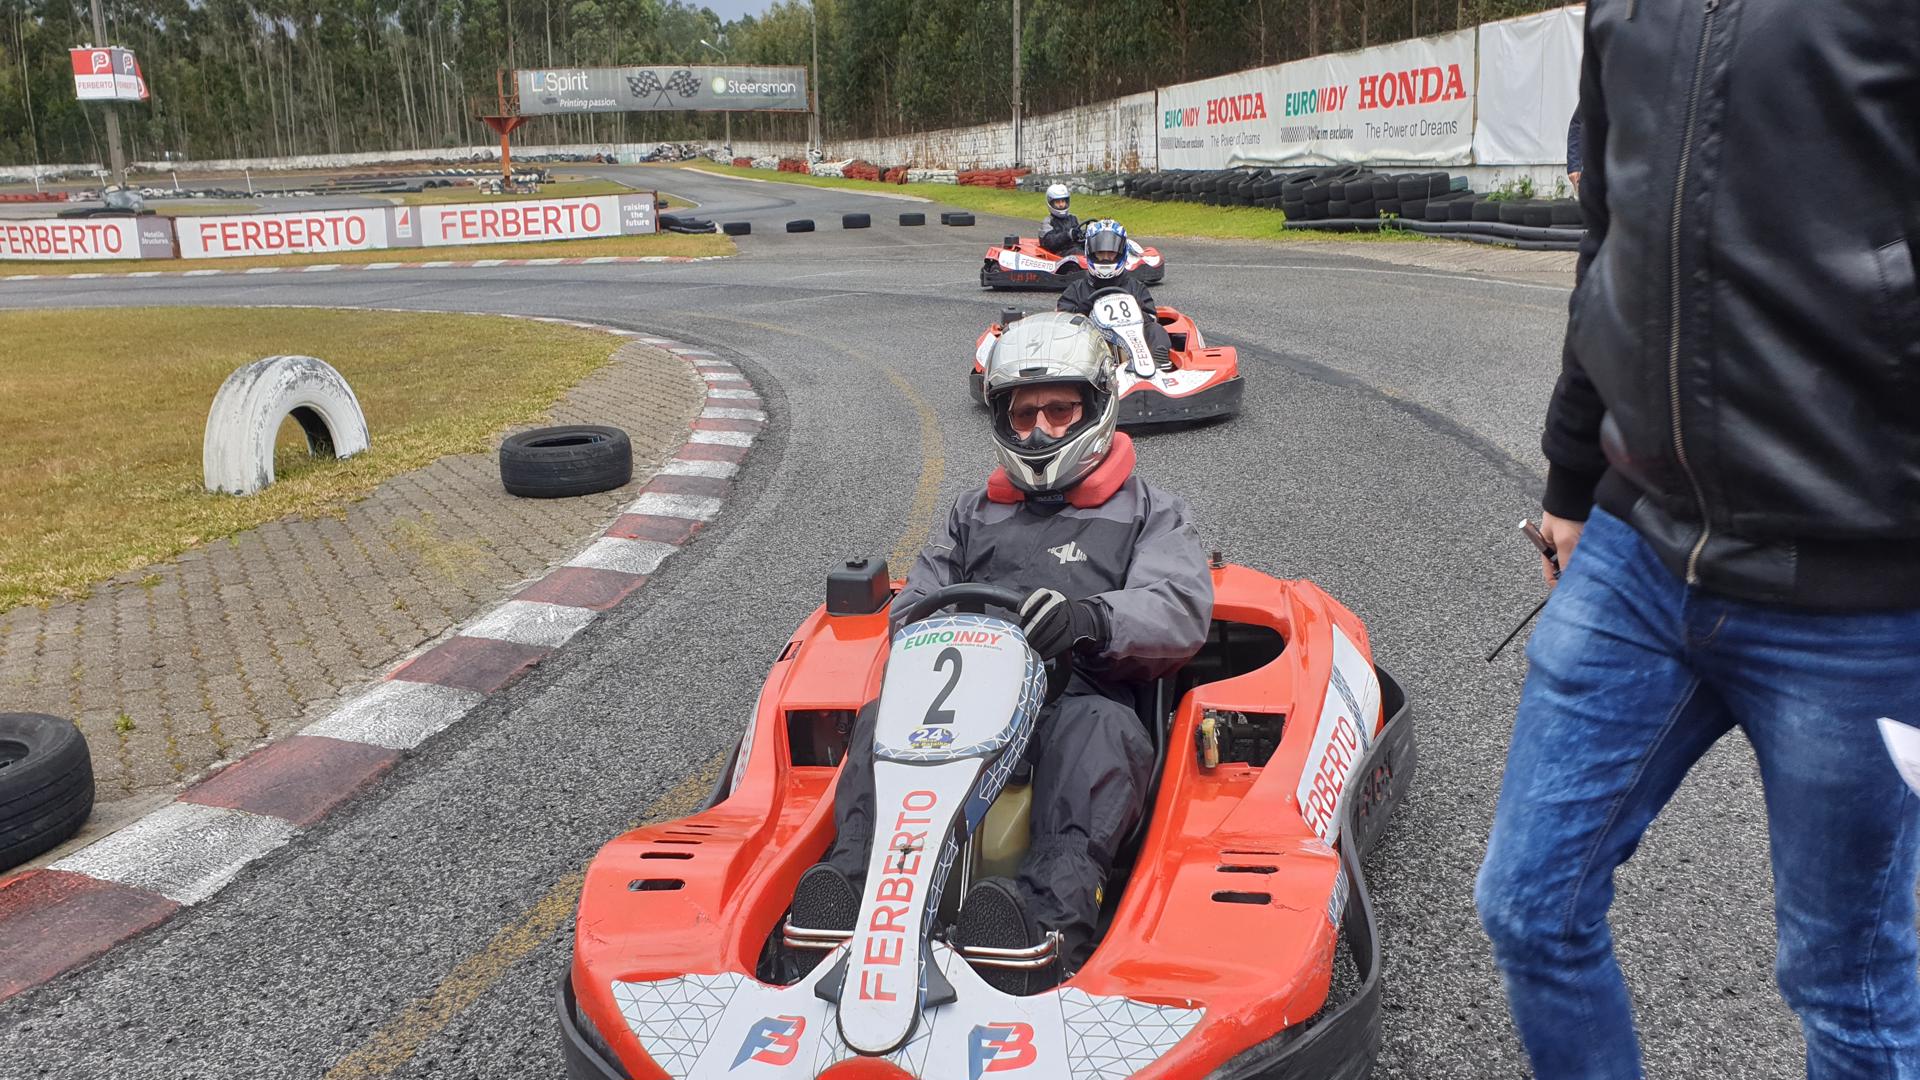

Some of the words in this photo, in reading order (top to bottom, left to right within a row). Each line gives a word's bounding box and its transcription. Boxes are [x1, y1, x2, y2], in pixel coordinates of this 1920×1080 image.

[546, 71, 589, 95] Spirit
[728, 80, 796, 93] Steersman
[1285, 85, 1348, 117] EUROINDY
[1358, 64, 1467, 110] HONDA
[560, 99, 588, 109] Printing
[1207, 93, 1267, 125] HONDA
[1365, 122, 1381, 139] The
[1383, 120, 1408, 138] Power
[1420, 119, 1458, 137] Dreams
[624, 203, 650, 214] raising
[631, 210, 644, 219] the
[438, 203, 601, 240] FERBERTO
[626, 218, 650, 227] future
[200, 215, 366, 252] FERBERTO
[1104, 300, 1132, 321] 28
[904, 631, 1001, 649] EUROINDY
[922, 647, 963, 725] 2
[1303, 716, 1356, 840] ERBERTO
[859, 789, 938, 1002] FERBERTO
